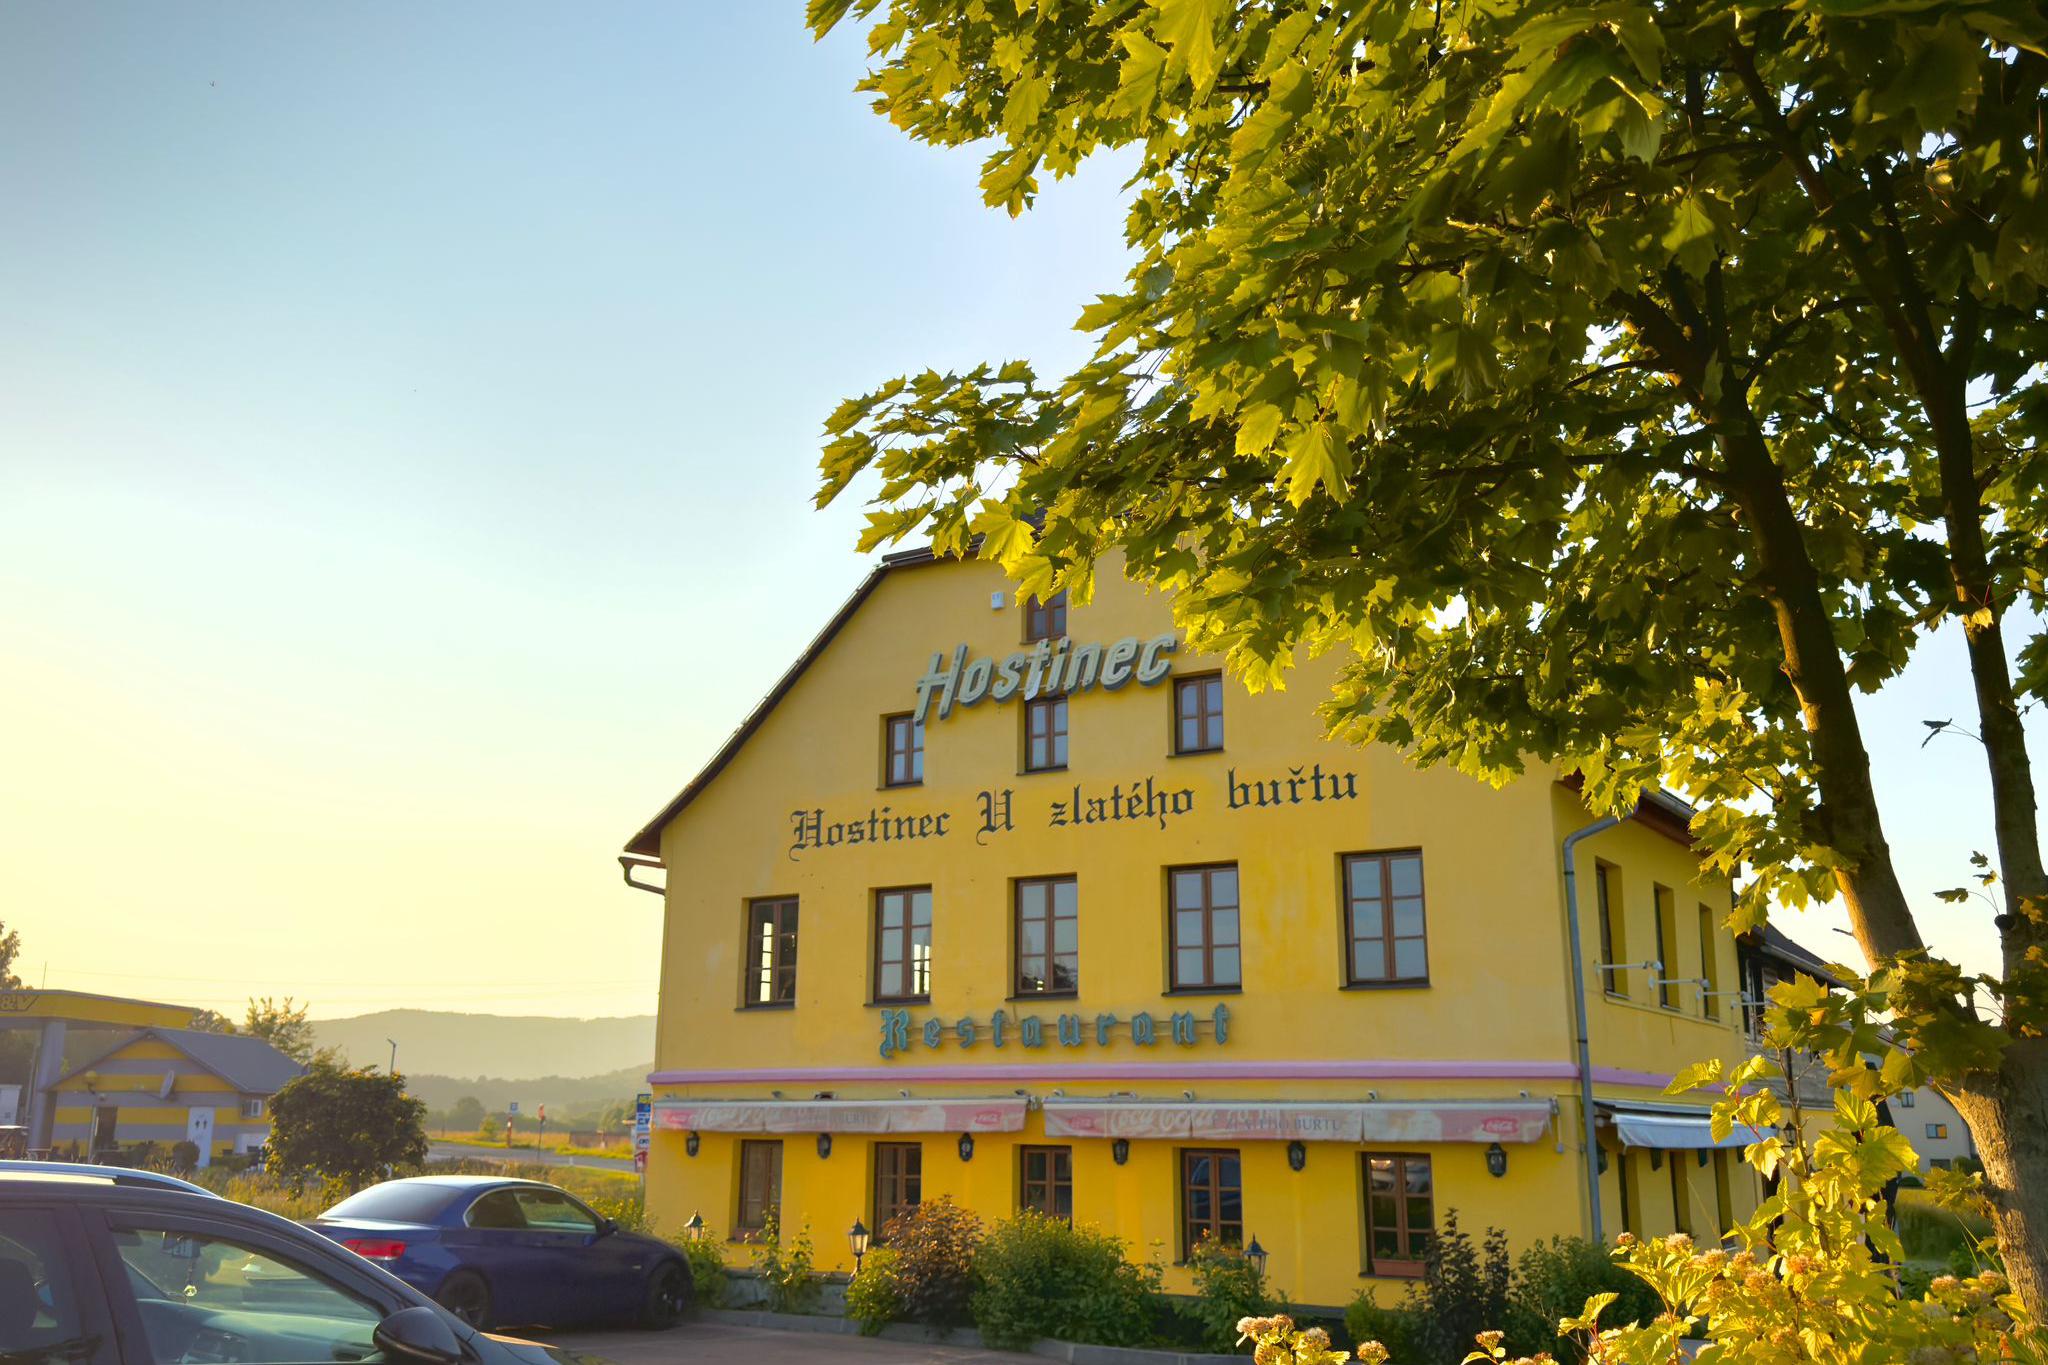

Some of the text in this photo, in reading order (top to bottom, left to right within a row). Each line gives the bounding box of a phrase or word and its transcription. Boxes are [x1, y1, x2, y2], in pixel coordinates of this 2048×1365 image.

[913, 634, 1178, 726] Hostinec
[788, 763, 1359, 862] Hostinec U zlatého buřtu
[879, 1001, 1231, 1060] Restaurant
